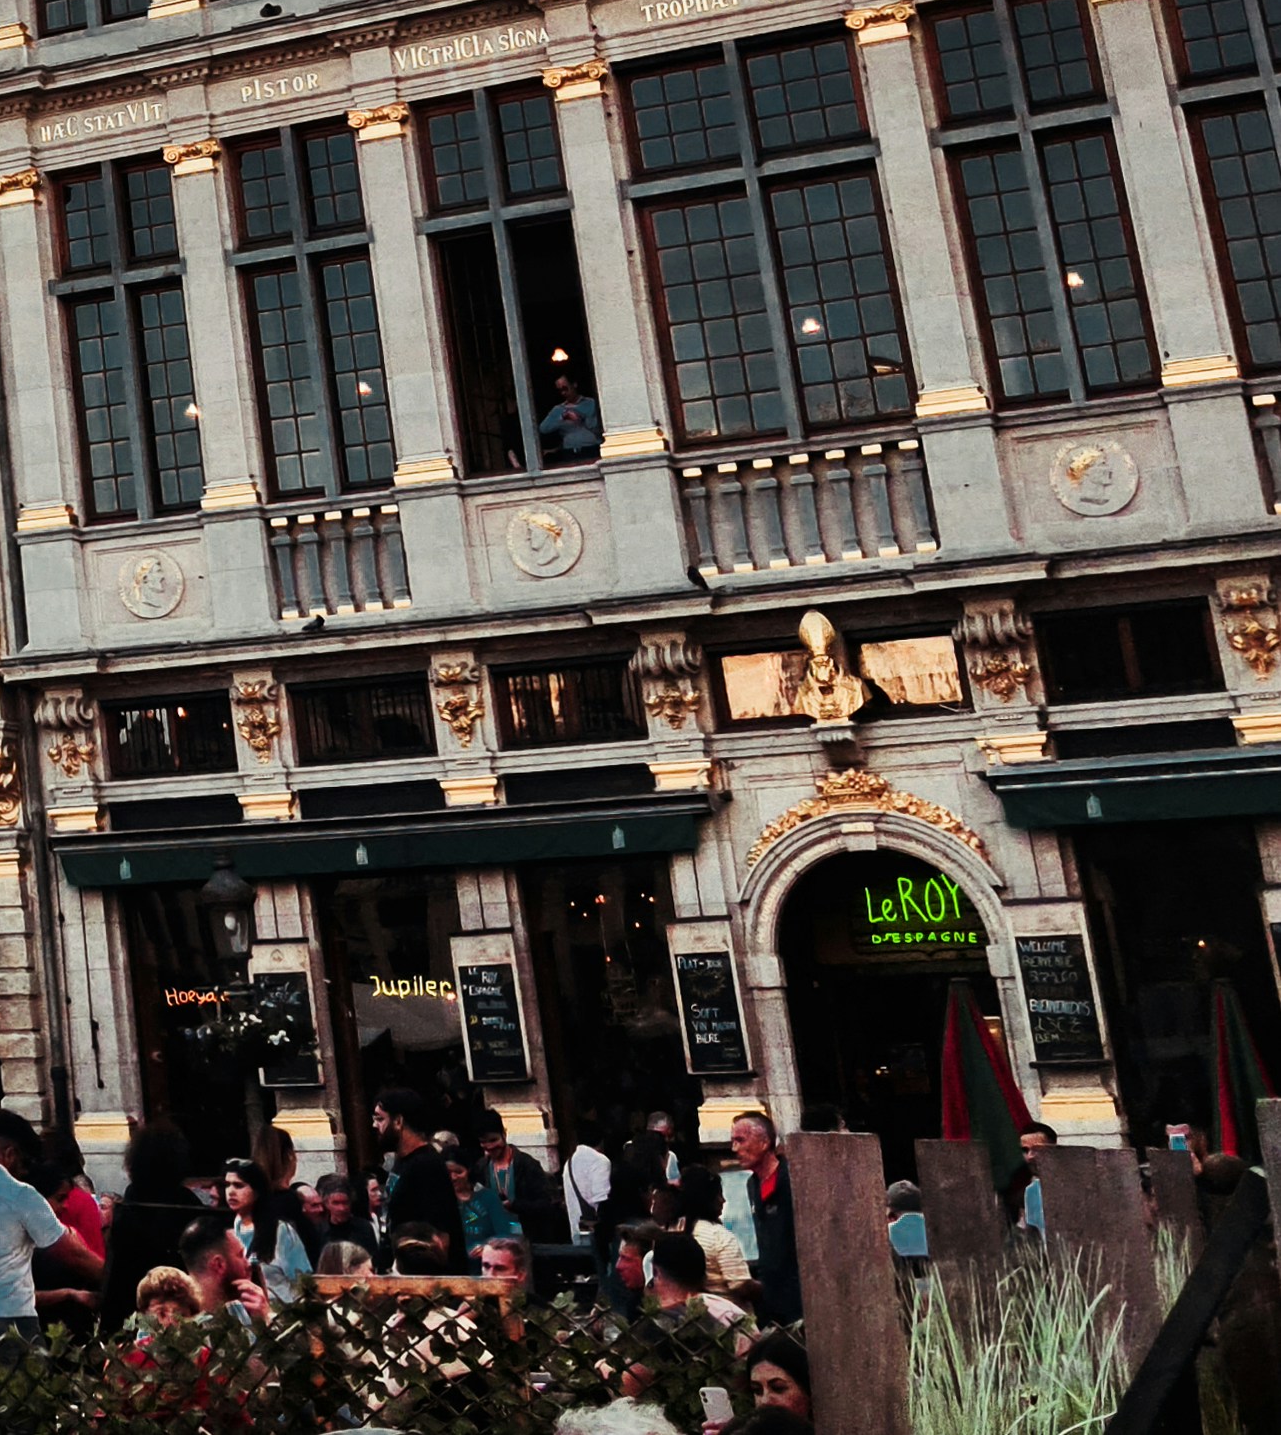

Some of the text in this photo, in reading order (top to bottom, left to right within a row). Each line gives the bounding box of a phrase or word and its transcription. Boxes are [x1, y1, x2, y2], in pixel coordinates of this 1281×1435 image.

[240, 72, 319, 103] PISTOR
[498, 27, 551, 52] SIGNA
[369, 974, 452, 1000] Jupiler
